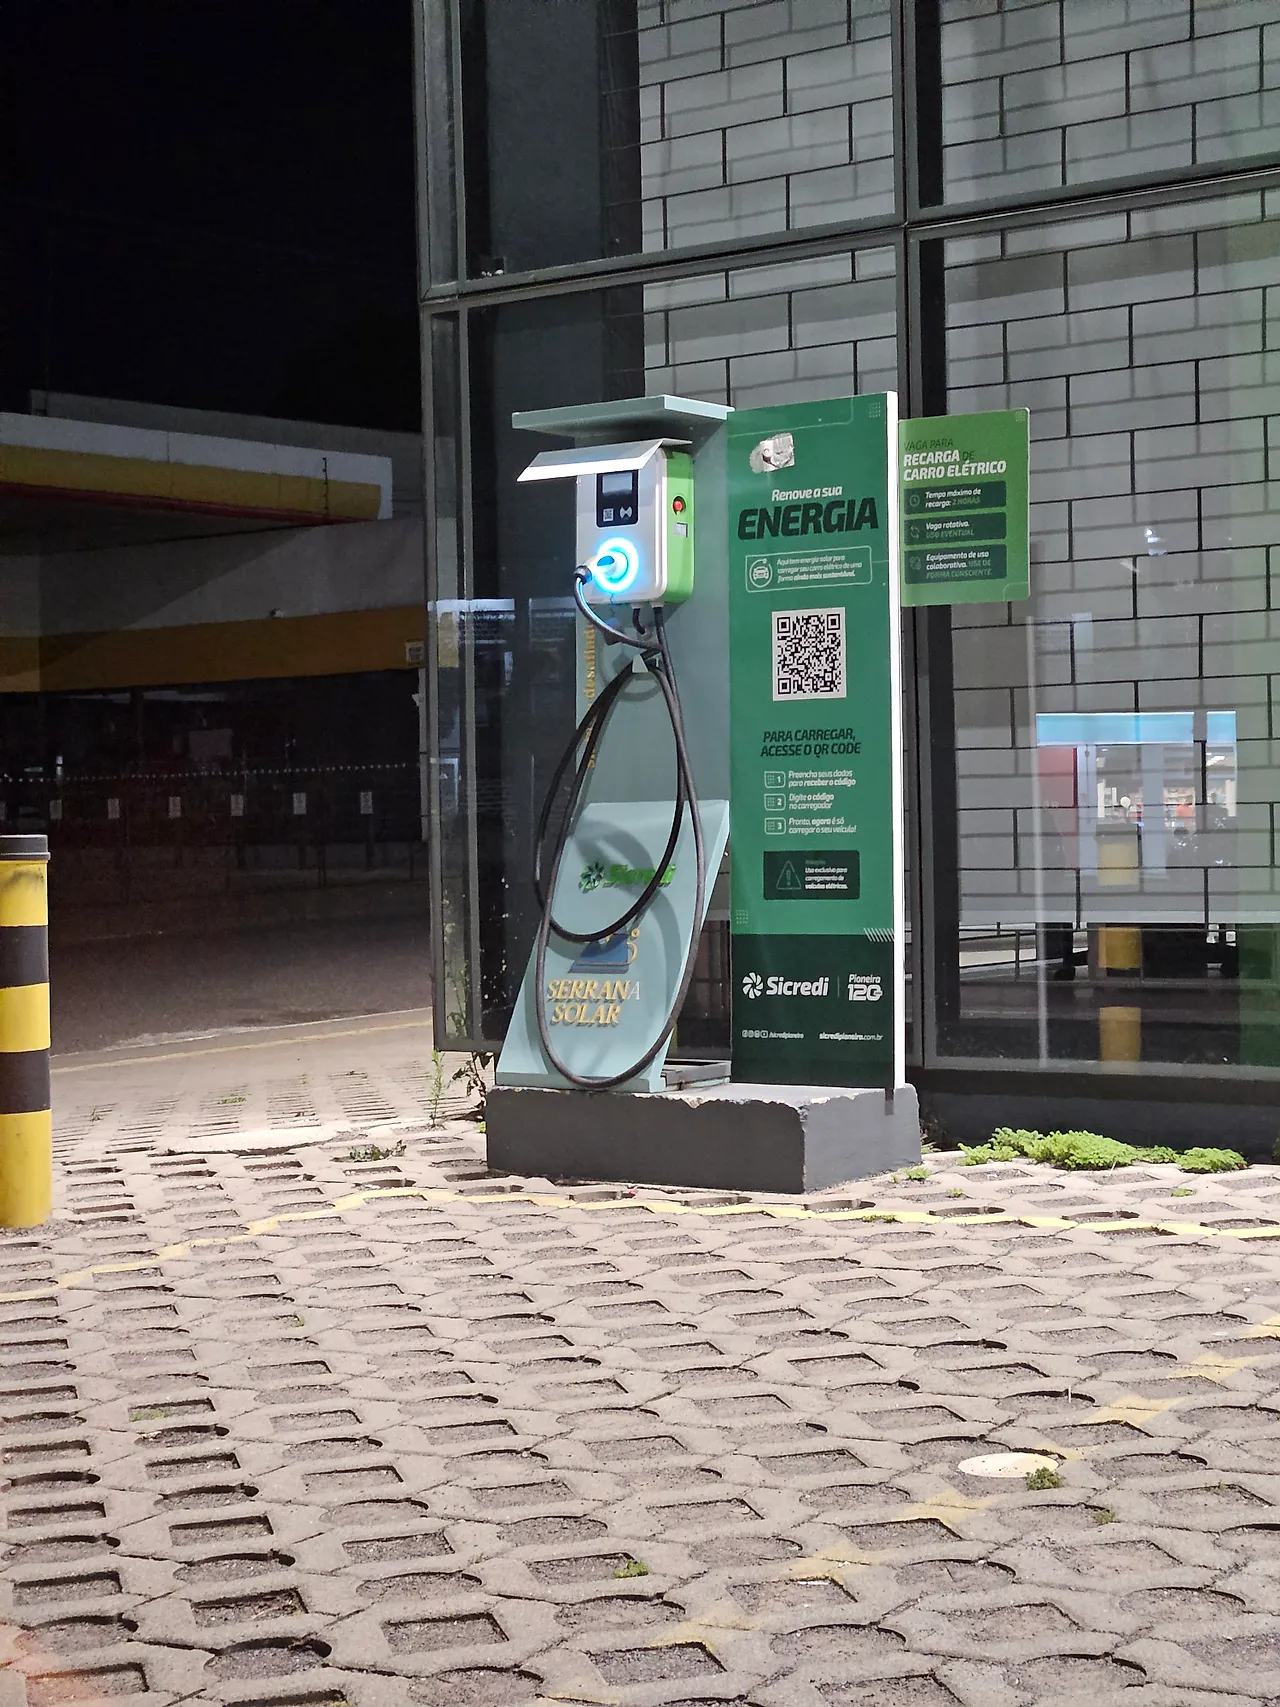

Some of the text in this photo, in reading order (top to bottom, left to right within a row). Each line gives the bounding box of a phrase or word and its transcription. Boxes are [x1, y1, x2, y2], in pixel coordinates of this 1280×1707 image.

[904, 438, 954, 451] VAGA PARA
[903, 449, 975, 467] RECARGA DE
[903, 460, 1007, 481] CARRO ELÉTRICO
[772, 486, 842, 501] Renove a sua
[925, 491, 946, 499] Tempo
[947, 489, 972, 497] máximo
[925, 500, 951, 509] recarga:
[738, 498, 879, 540] ENERGIA
[925, 521, 970, 531] Vaga rotativa.
[941, 529, 975, 538] EVENTUAL
[926, 551, 968, 562] Equipamento
[926, 562, 968, 571] colaborativa.
[763, 728, 856, 743] PARA CARREGAR,
[760, 742, 861, 758] ACESSE O QR CODE
[788, 770, 818, 778] Preencha
[833, 769, 853, 777] dados
[788, 780, 803, 788] para
[804, 778, 829, 786] receber
[834, 777, 856, 787] código
[789, 793, 807, 803] Digite
[812, 792, 835, 802] código
[798, 801, 833, 811] carregador
[788, 817, 811, 826] Pronto,
[811, 818, 831, 827] agora
[836, 816, 845, 824] só
[788, 827, 816, 836] carregar
[832, 825, 857, 833] veículo!
[848, 973, 881, 983] Pioneira
[546, 979, 640, 1001] SERRANA
[766, 976, 830, 997] Sicredi
[551, 1003, 621, 1025] SOLAR
[819, 1032, 884, 1041] sicredipioneira.com.br
